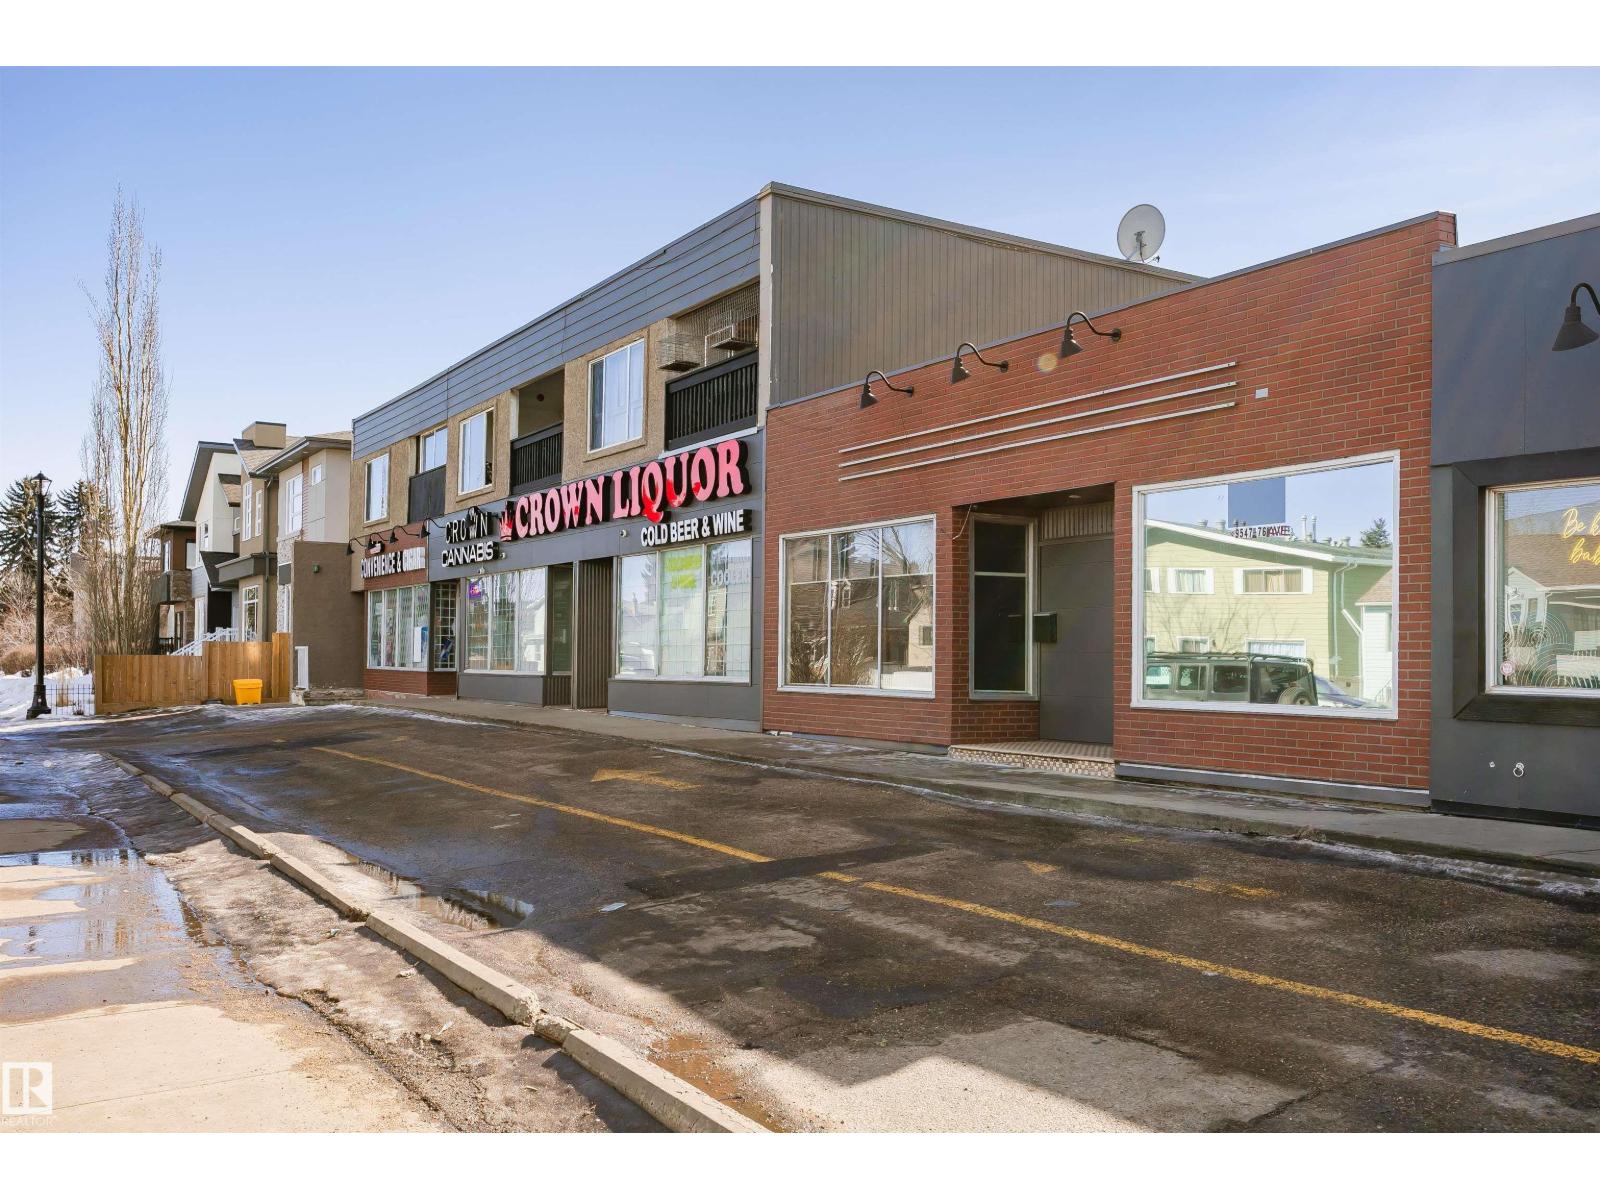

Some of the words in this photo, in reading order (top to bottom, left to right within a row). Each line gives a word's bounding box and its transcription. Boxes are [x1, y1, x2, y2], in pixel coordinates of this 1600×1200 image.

[514, 475, 605, 538] CROWN
[612, 439, 744, 524] LIQUOR
[640, 524, 669, 547] COLD
[670, 517, 700, 543] BEER
[701, 515, 711, 538] &
[712, 509, 744, 535] WINE
[441, 541, 494, 568] CANNABIS
